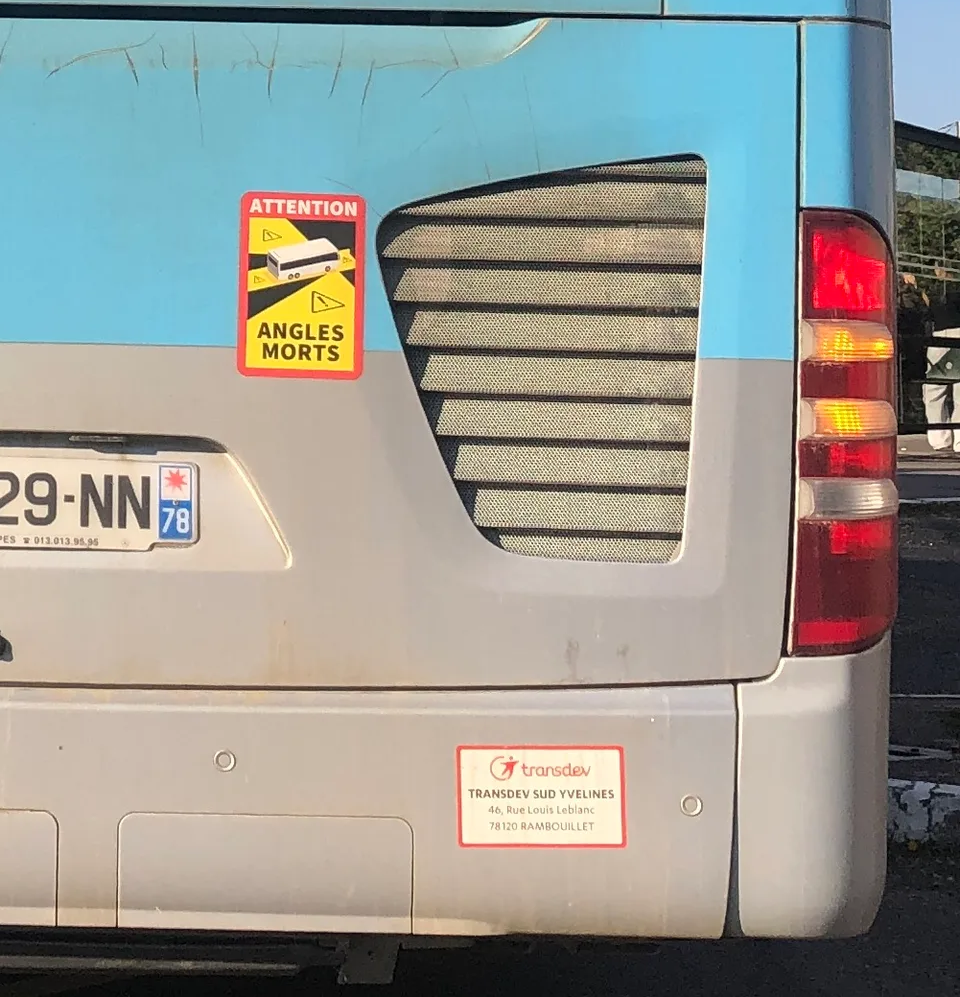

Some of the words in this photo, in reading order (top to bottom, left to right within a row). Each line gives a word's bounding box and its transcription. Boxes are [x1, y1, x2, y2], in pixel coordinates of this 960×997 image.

[249, 198, 358, 216] ATTENTION
[257, 322, 344, 341] ANGLES
[262, 343, 340, 362] MORTS
[161, 507, 191, 534] 78
[521, 763, 591, 777] transdev
[468, 789, 530, 799] TRANSDEV
[533, 789, 556, 799] SUD
[560, 789, 615, 799] YVELINES
[488, 806, 504, 816] 46,
[506, 806, 526, 815] Rue
[528, 806, 554, 815] Louis
[557, 806, 595, 815] Leblanc
[489, 822, 518, 831] 78120
[520, 822, 595, 831] RAMBOUILLET
